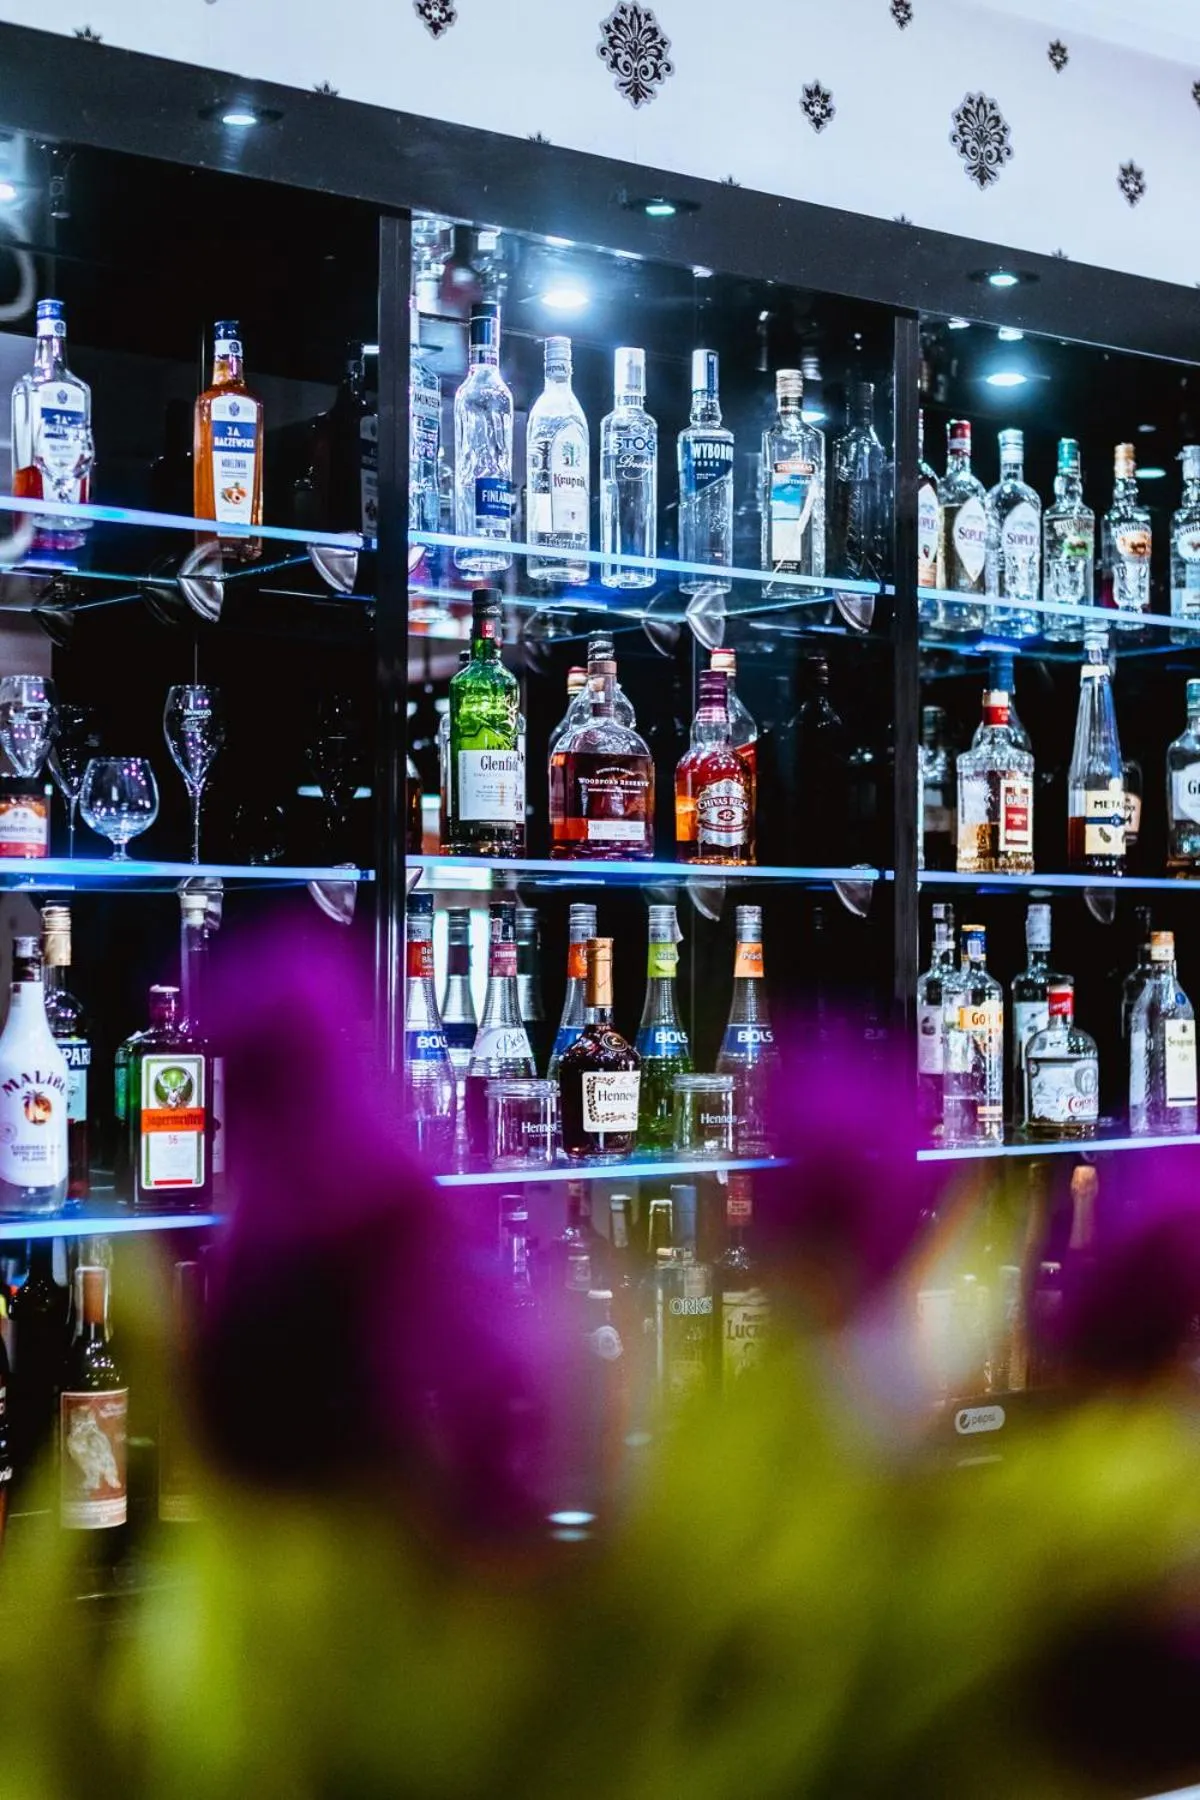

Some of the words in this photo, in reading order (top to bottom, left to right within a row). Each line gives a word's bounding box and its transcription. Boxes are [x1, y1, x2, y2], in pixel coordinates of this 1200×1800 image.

[613, 437, 656, 451] STOC
[655, 1031, 689, 1044] BOLS
[737, 1030, 774, 1043] BOLS
